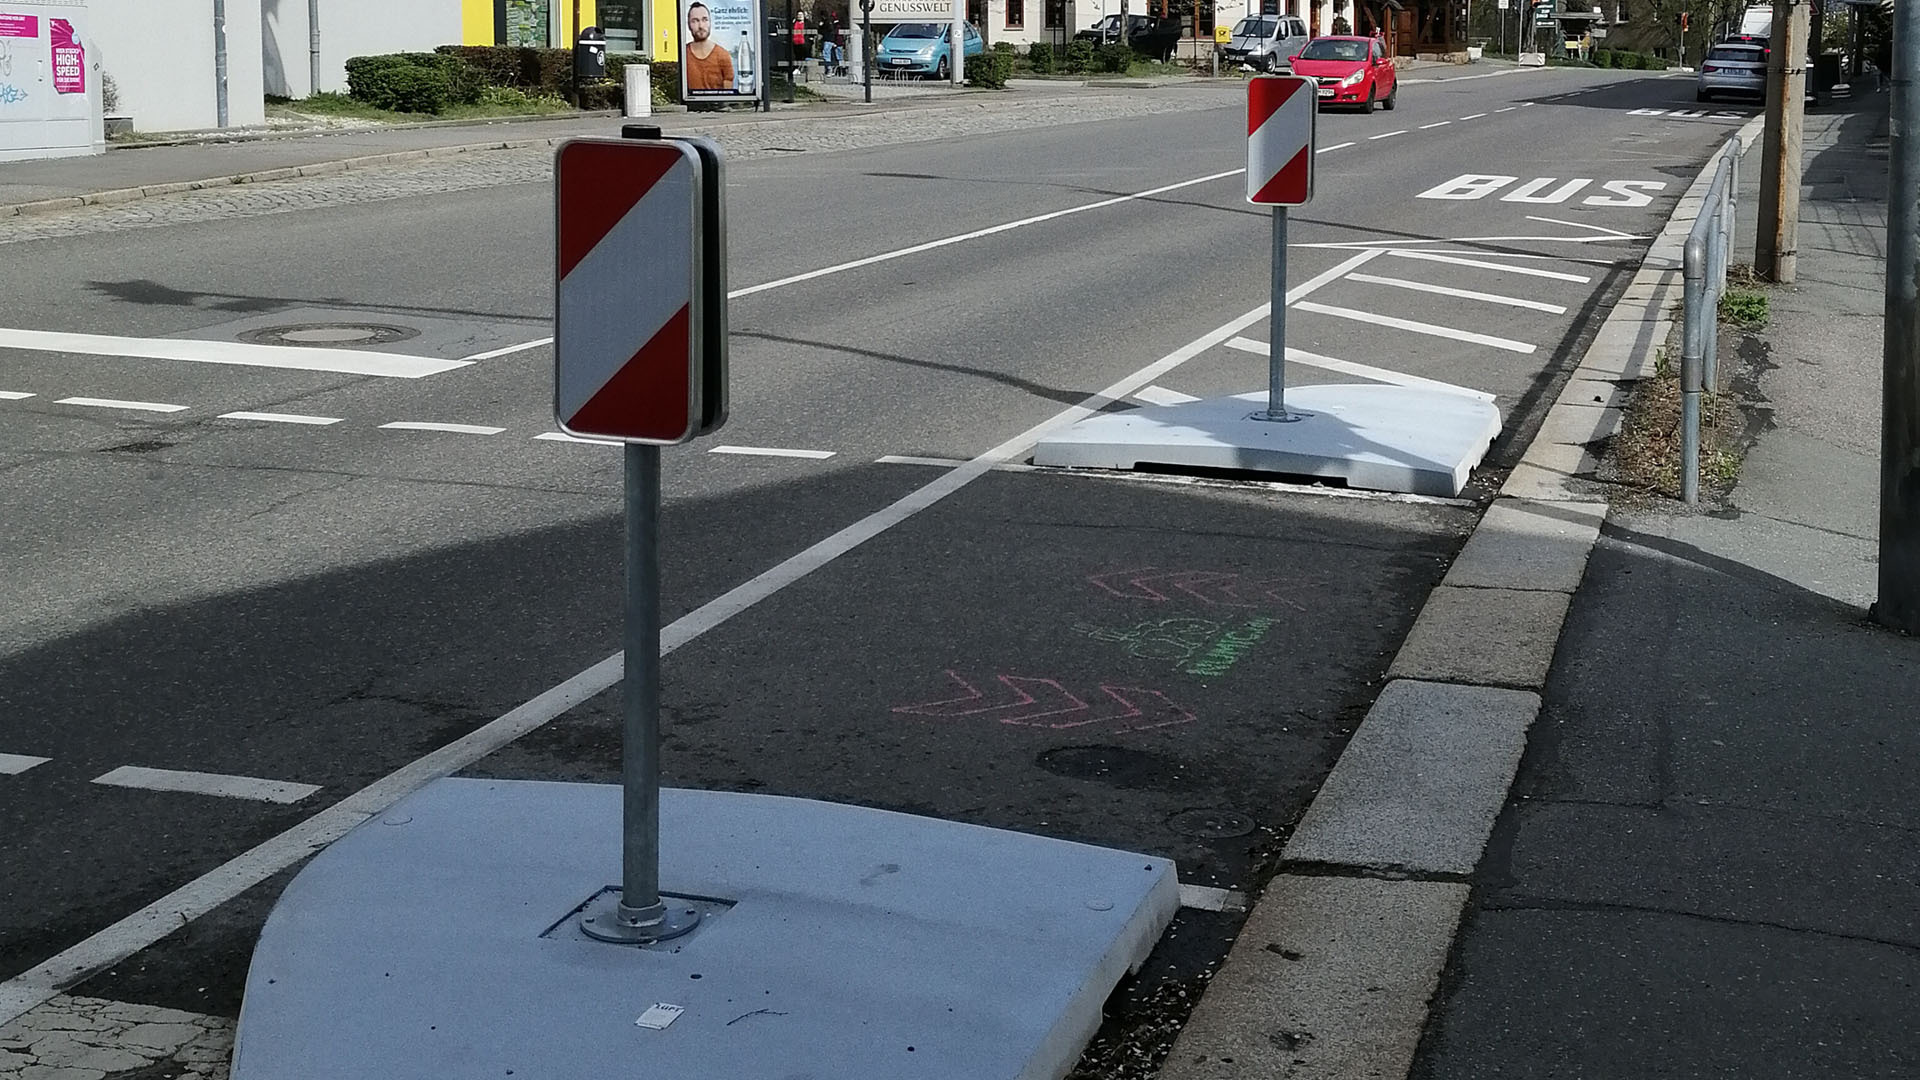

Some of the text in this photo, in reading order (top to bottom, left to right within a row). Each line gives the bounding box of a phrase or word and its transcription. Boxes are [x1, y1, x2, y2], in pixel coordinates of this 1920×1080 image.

[880, 3, 951, 12] GENUSSWELT
[56, 54, 79, 65] HIGH-
[56, 66, 80, 76] SPEED
[1626, 108, 1748, 119] BUS
[1416, 174, 1667, 207] BUS
